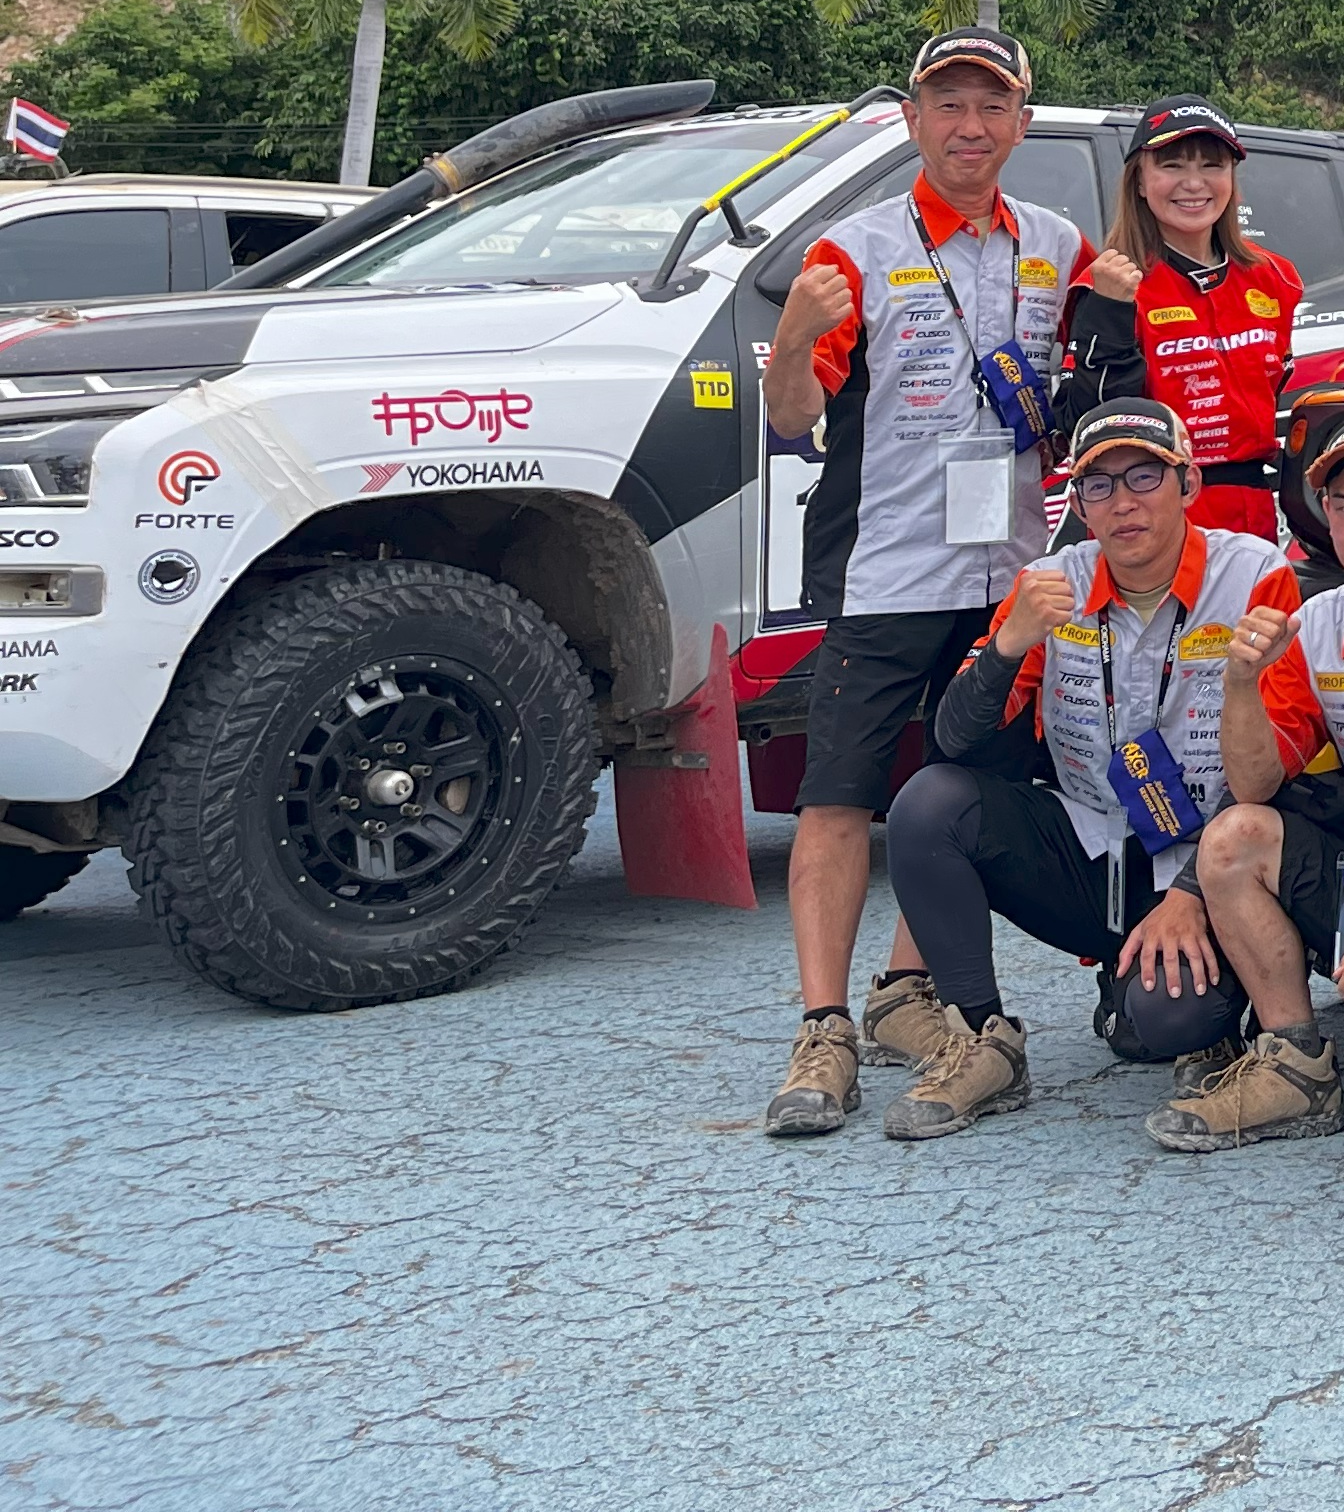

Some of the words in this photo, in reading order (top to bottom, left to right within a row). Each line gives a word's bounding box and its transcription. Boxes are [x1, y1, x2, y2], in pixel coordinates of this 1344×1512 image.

[894, 269, 940, 283] PROPA
[695, 380, 731, 398] T1D
[407, 459, 545, 487] YOKOHAMA
[135, 513, 235, 530] FORTE
[1059, 625, 1102, 643] PROPA
